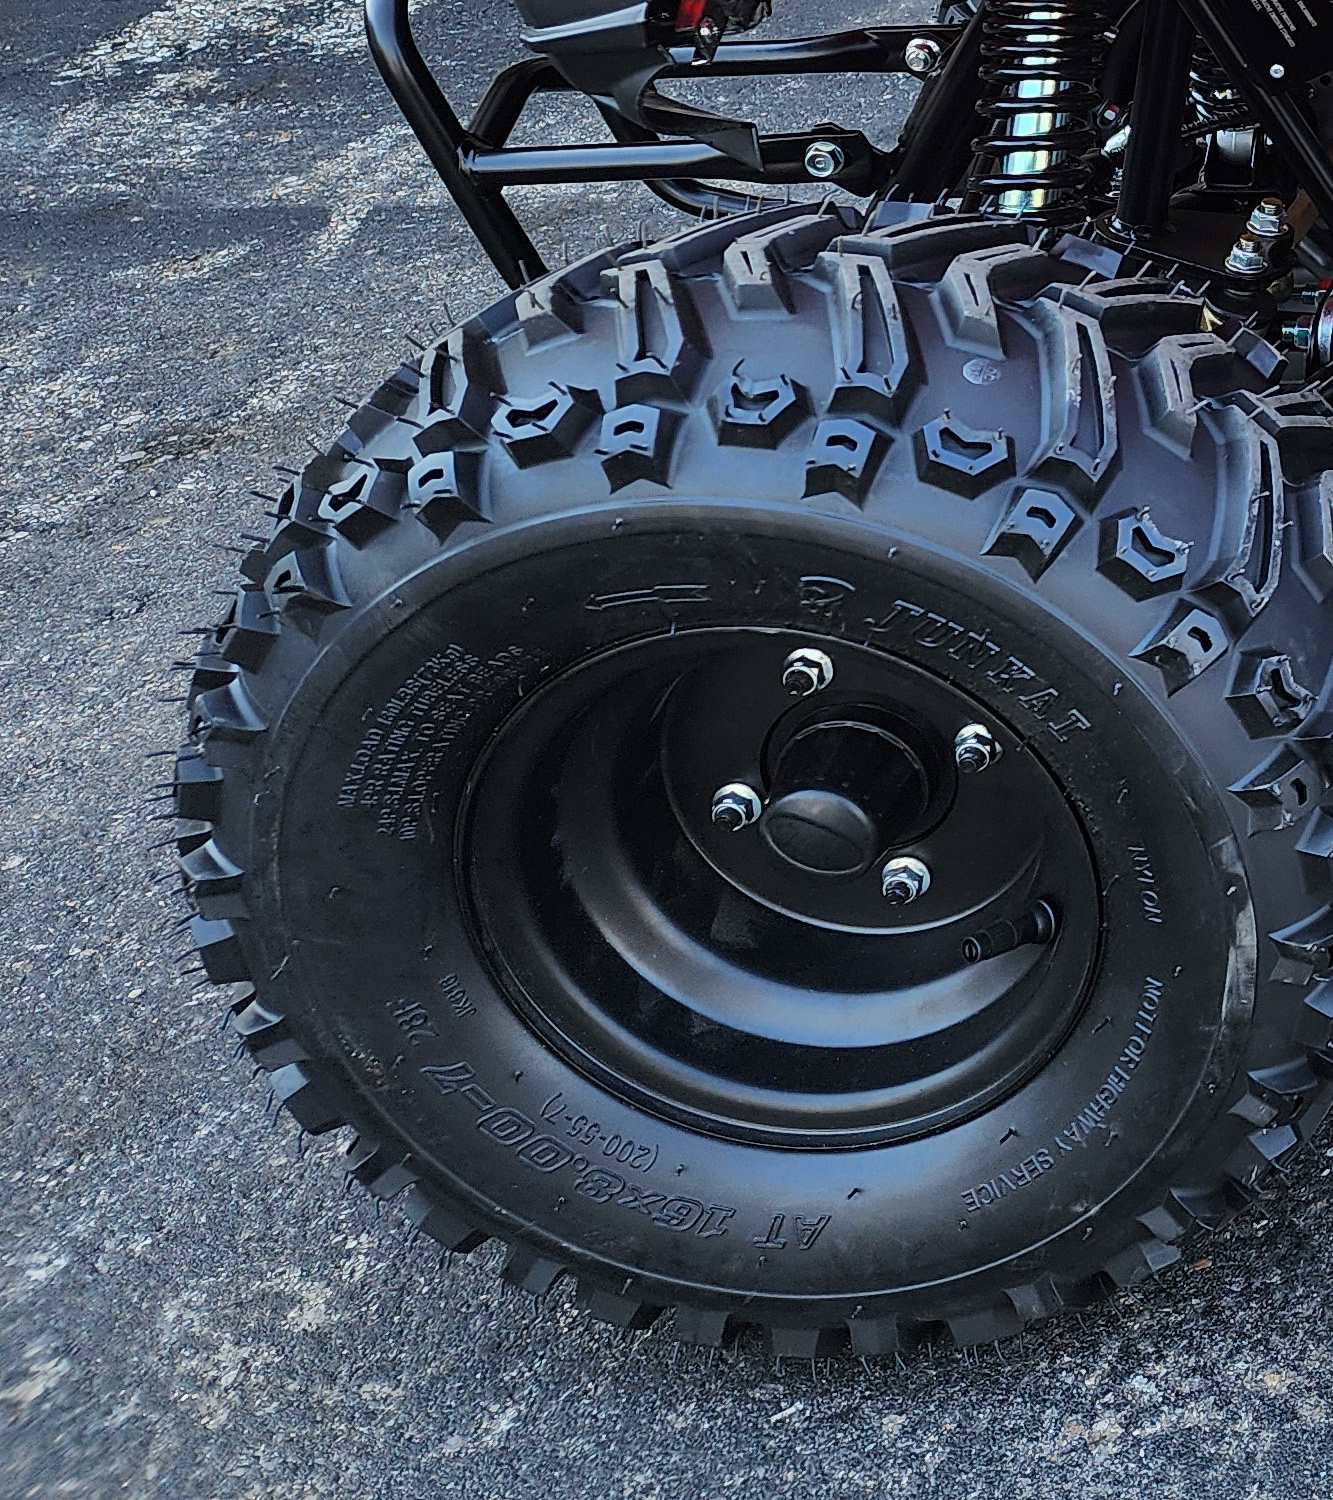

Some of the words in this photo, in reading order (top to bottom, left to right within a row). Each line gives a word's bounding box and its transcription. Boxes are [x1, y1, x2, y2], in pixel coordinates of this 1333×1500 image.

[862, 596, 1092, 743] JUNKAI
[1116, 1019, 1152, 1071] FOR
[538, 1089, 660, 1175] (200-55-7)
[1051, 1064, 1130, 1156] HIGHWAY
[961, 1147, 1055, 1213] SERVICE
[751, 1212, 832, 1252] AT
